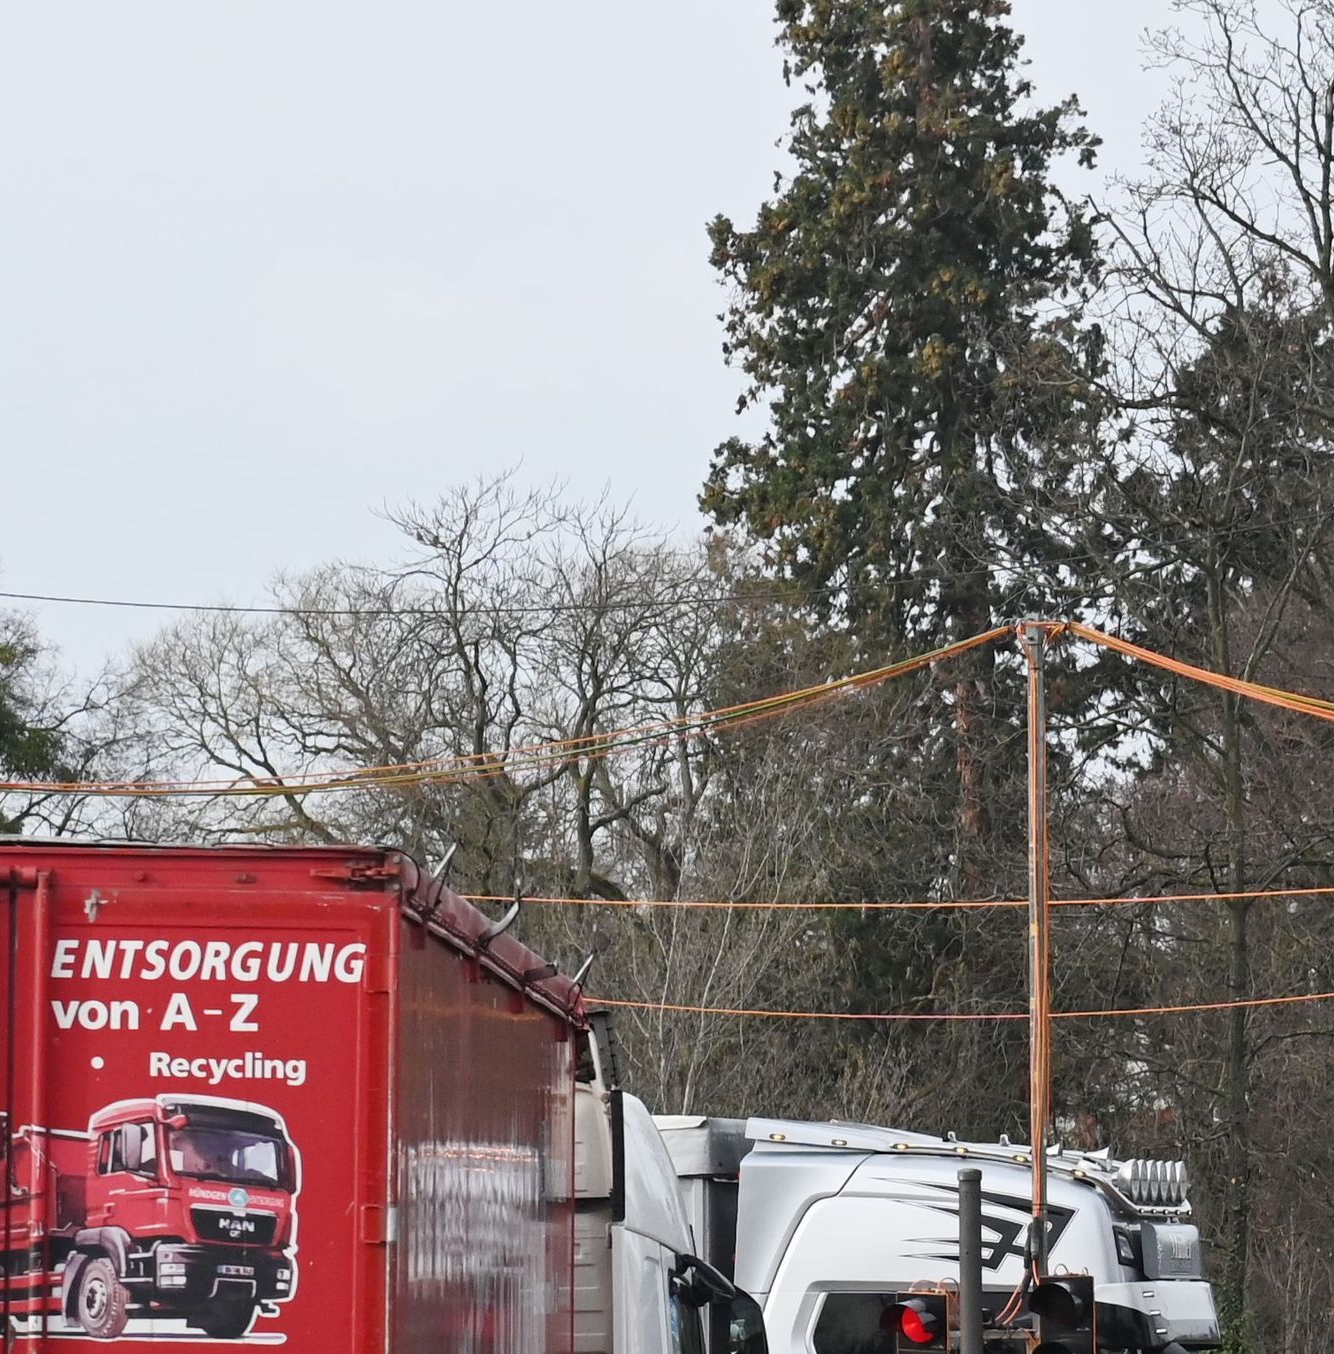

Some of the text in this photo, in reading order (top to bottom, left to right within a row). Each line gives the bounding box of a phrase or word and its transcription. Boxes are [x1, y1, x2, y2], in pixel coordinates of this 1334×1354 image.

[50, 939, 367, 983] ENTSORGUNG
[51, 1000, 139, 1030] von
[149, 1052, 307, 1086] Recycling
